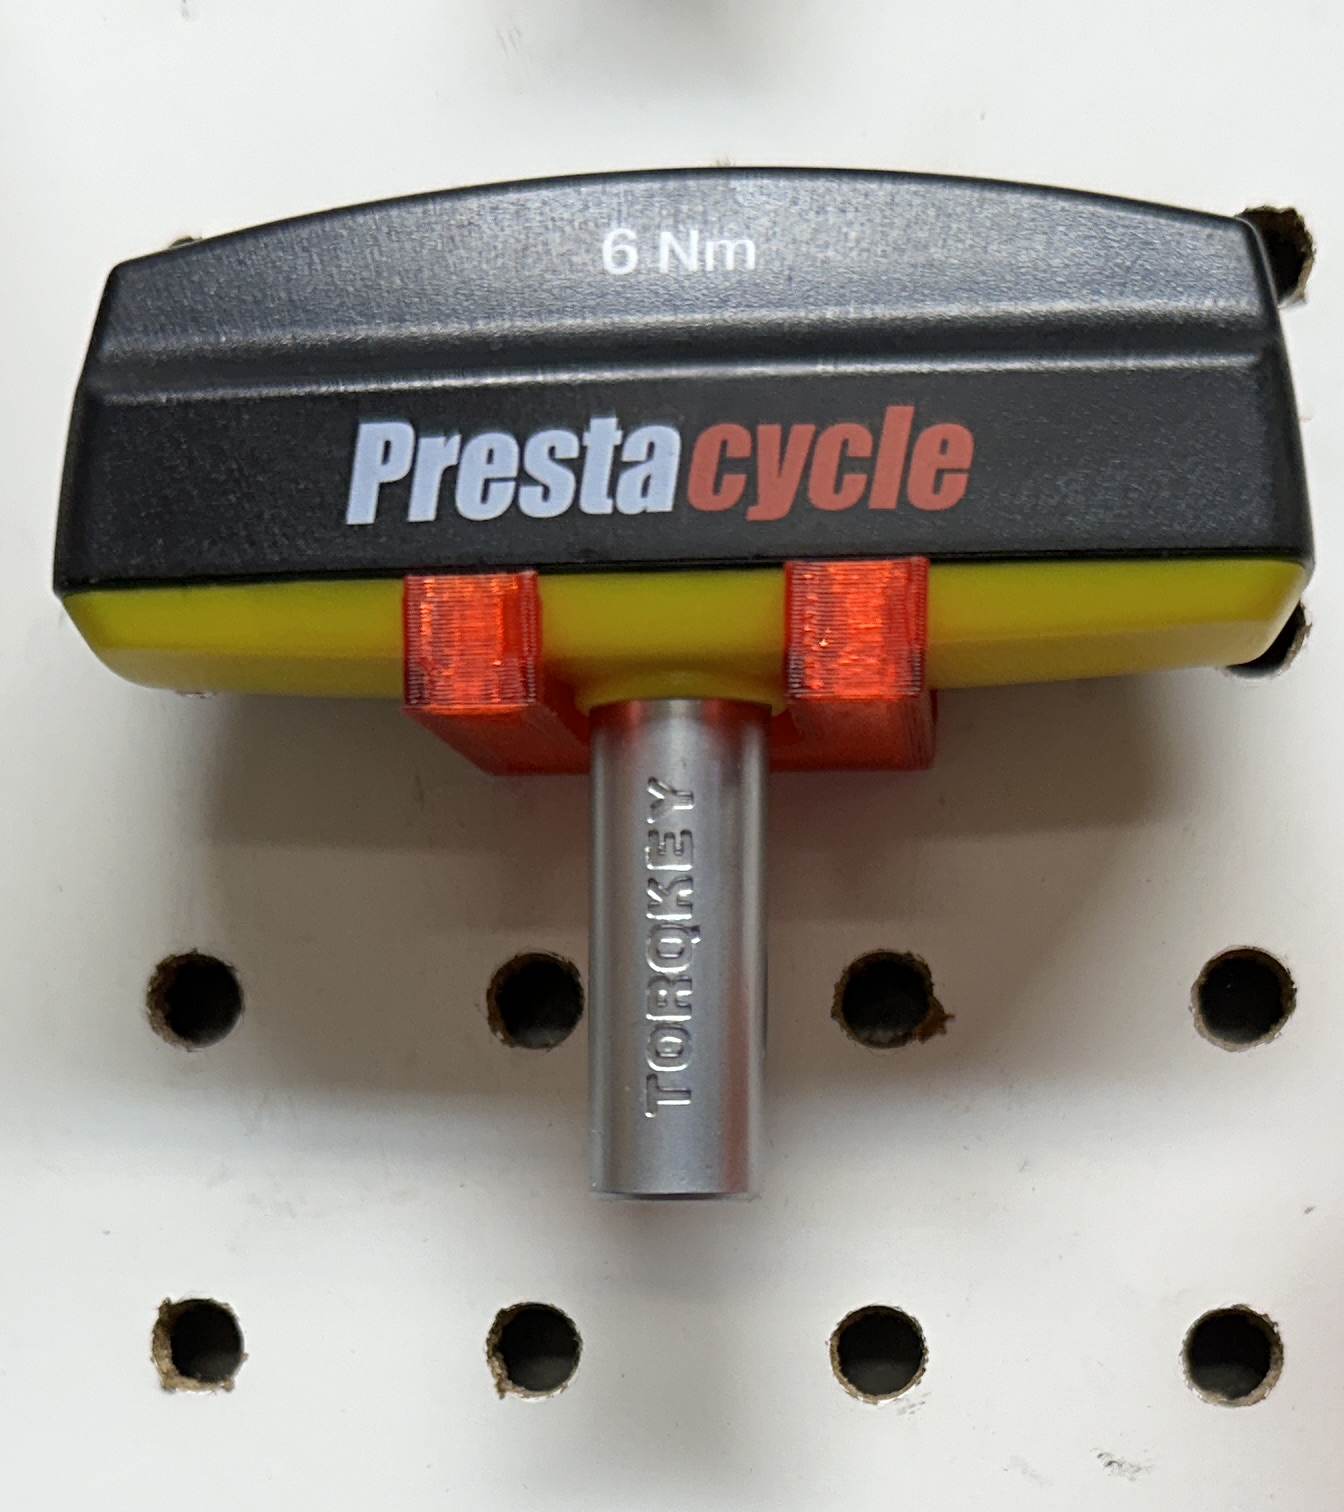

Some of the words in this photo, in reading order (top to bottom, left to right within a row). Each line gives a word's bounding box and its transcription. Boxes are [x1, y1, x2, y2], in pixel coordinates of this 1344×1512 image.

[601, 228, 639, 276] 6
[658, 229, 756, 273] Nm
[345, 405, 975, 525] Prestacycle
[644, 776, 701, 1119] TORQKEY
